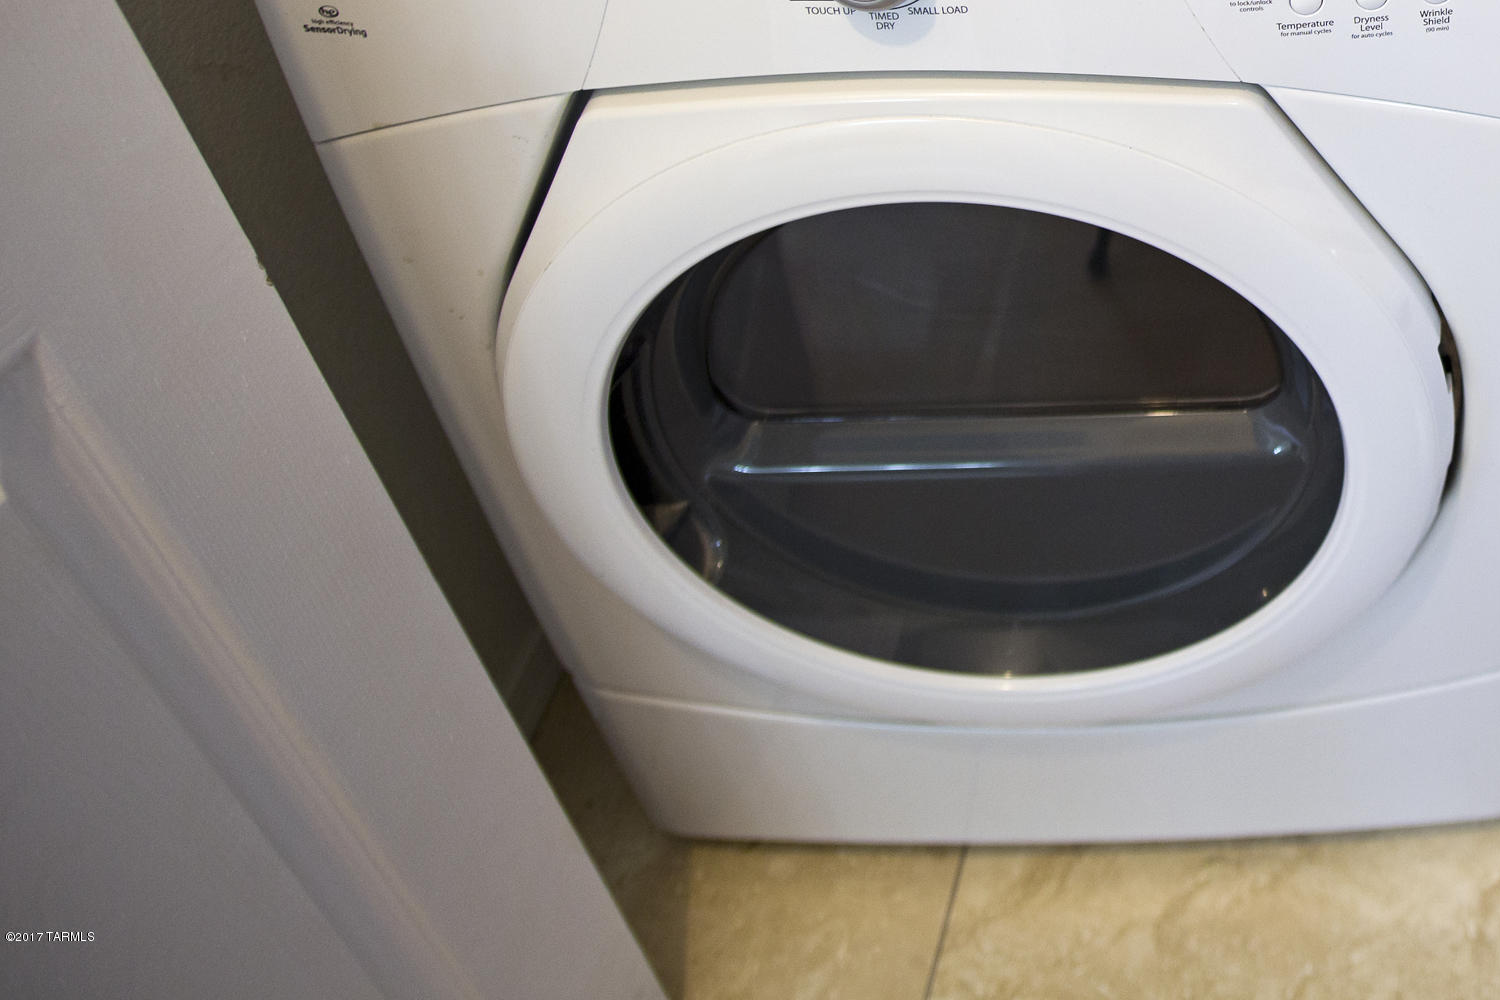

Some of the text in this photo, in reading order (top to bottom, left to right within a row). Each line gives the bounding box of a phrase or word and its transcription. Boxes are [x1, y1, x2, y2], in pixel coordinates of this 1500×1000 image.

[805, 6, 857, 15] TOUCH UP
[907, 5, 968, 15] SMALL LOAD
[1420, 7, 1453, 18] Wrinkle
[868, 12, 900, 20] TIMED
[1353, 15, 1389, 25] Dryness
[1423, 16, 1450, 26] Shield
[876, 22, 895, 30] DRY
[1276, 19, 1335, 31] Temperature
[1360, 23, 1383, 32] Level
